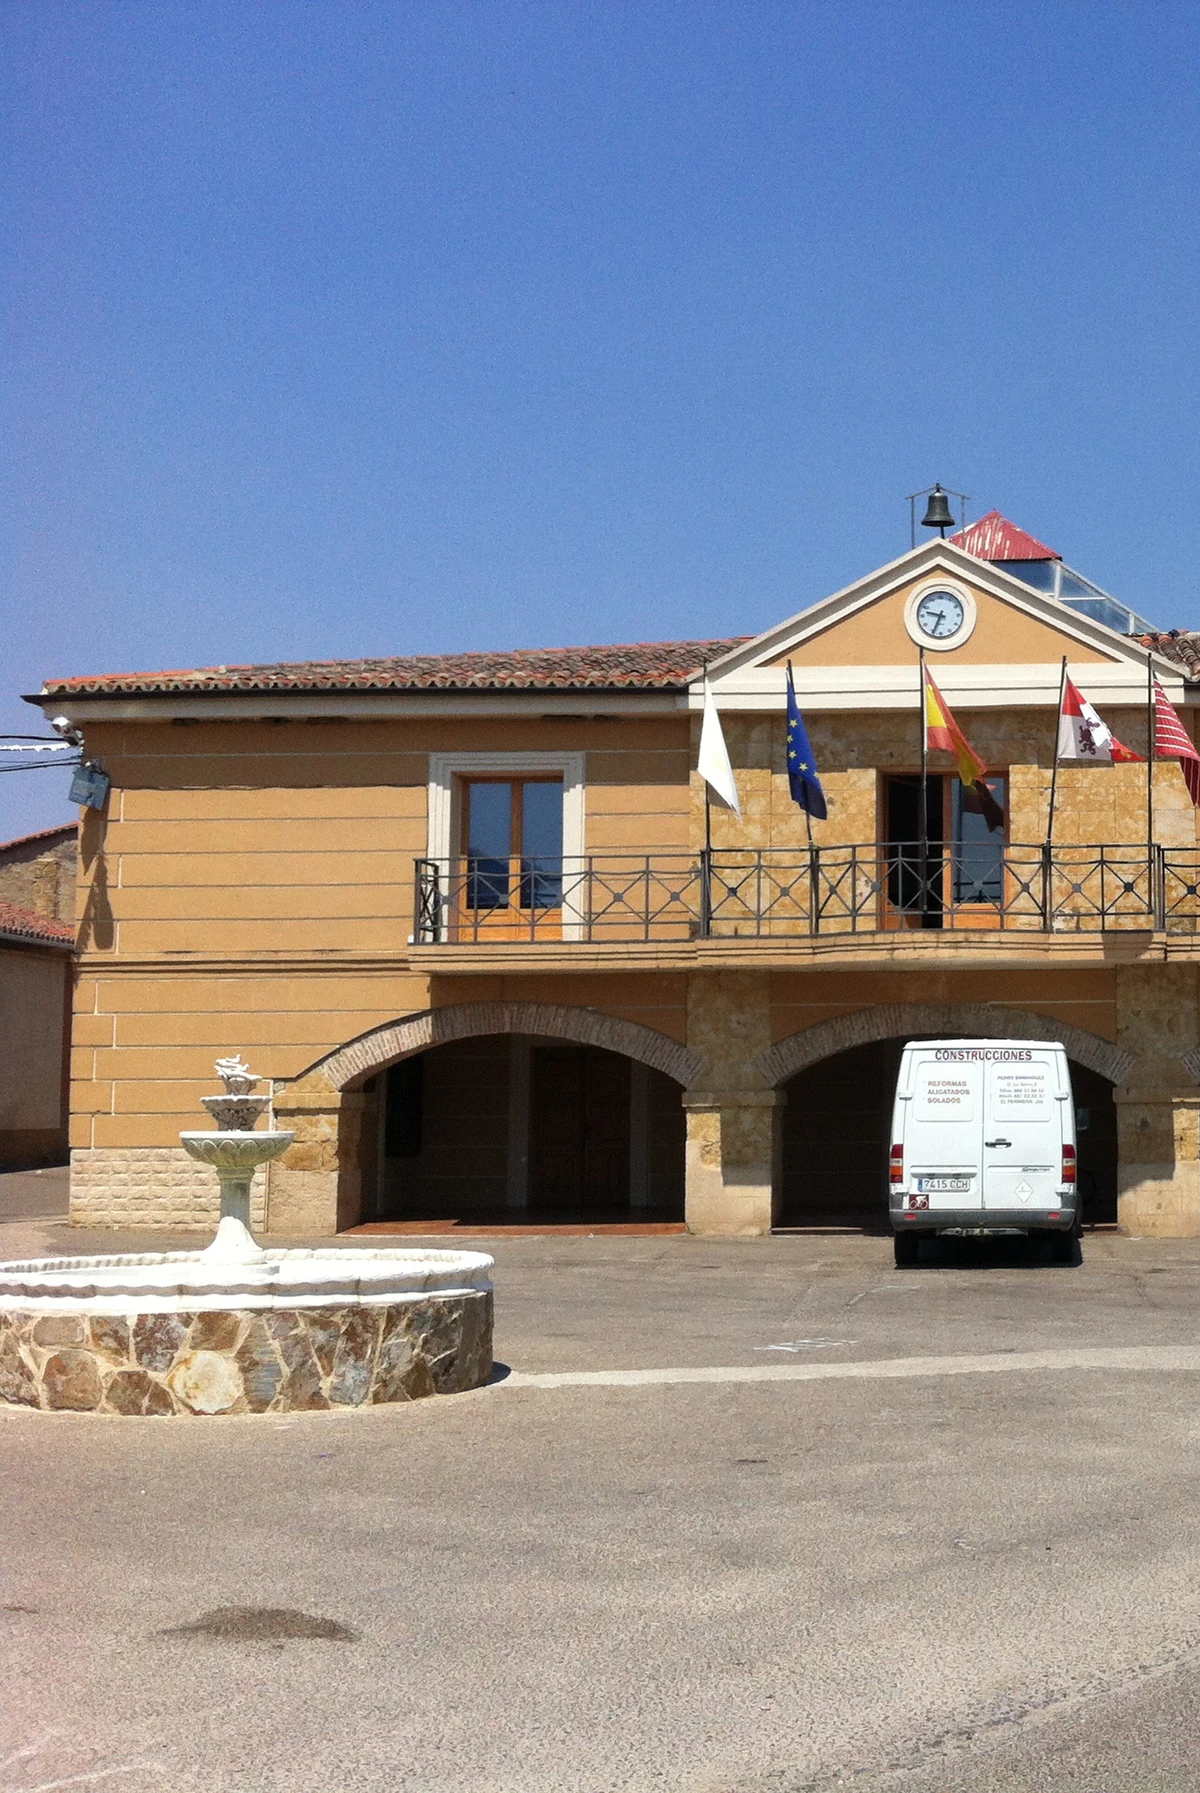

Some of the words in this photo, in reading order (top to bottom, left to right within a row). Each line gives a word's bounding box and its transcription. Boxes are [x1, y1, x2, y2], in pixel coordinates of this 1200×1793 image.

[935, 1050, 1032, 1061] CONSTRUCCIONES
[924, 1180, 948, 1188] 7415
[949, 1180, 968, 1188] CCH
